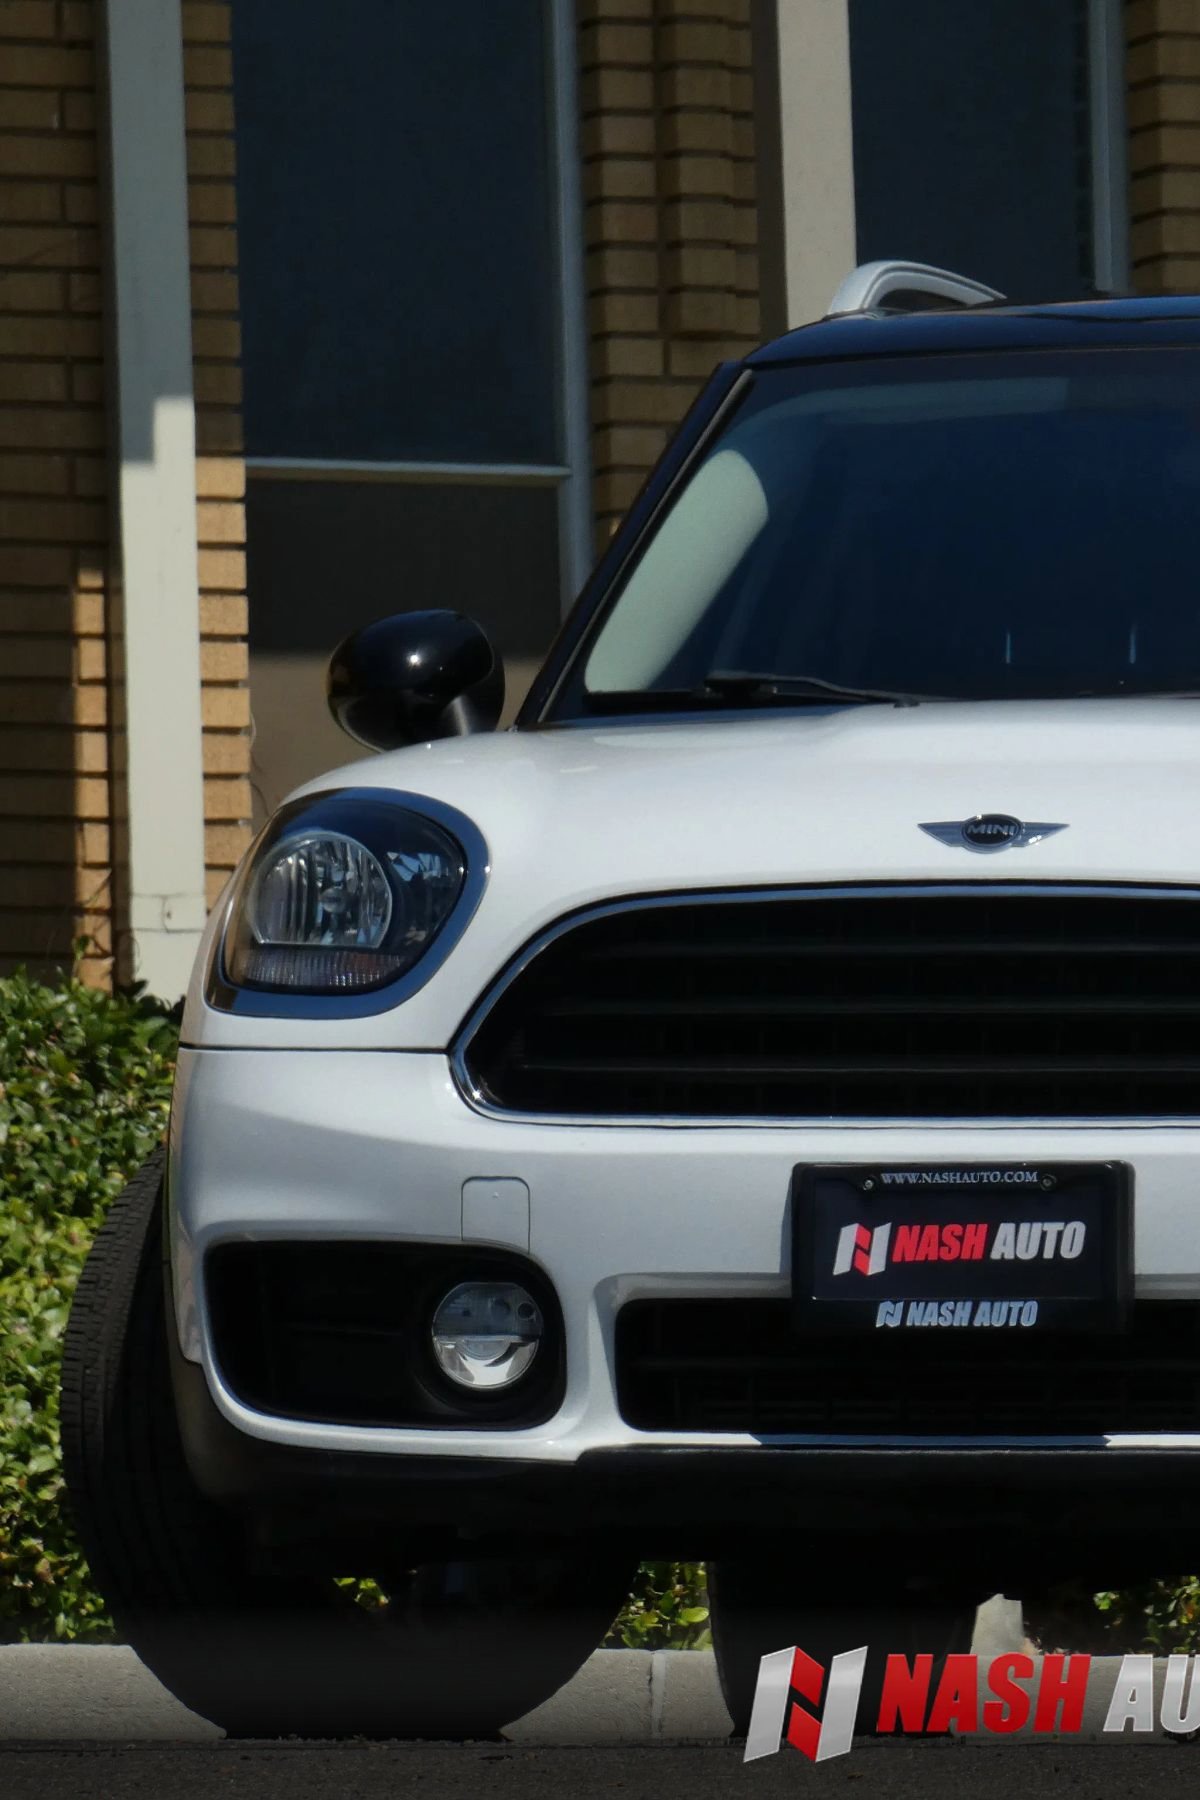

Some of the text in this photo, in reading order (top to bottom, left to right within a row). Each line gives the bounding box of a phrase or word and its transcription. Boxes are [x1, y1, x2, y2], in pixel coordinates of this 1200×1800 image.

[968, 824, 1016, 836] MINI
[881, 1171, 1038, 1184] WWW.NASHAUTO.COM
[892, 1223, 988, 1262] NASH
[990, 1221, 1086, 1260] AUTO
[906, 1301, 972, 1327] NASH
[973, 1301, 1038, 1327] AUTO
